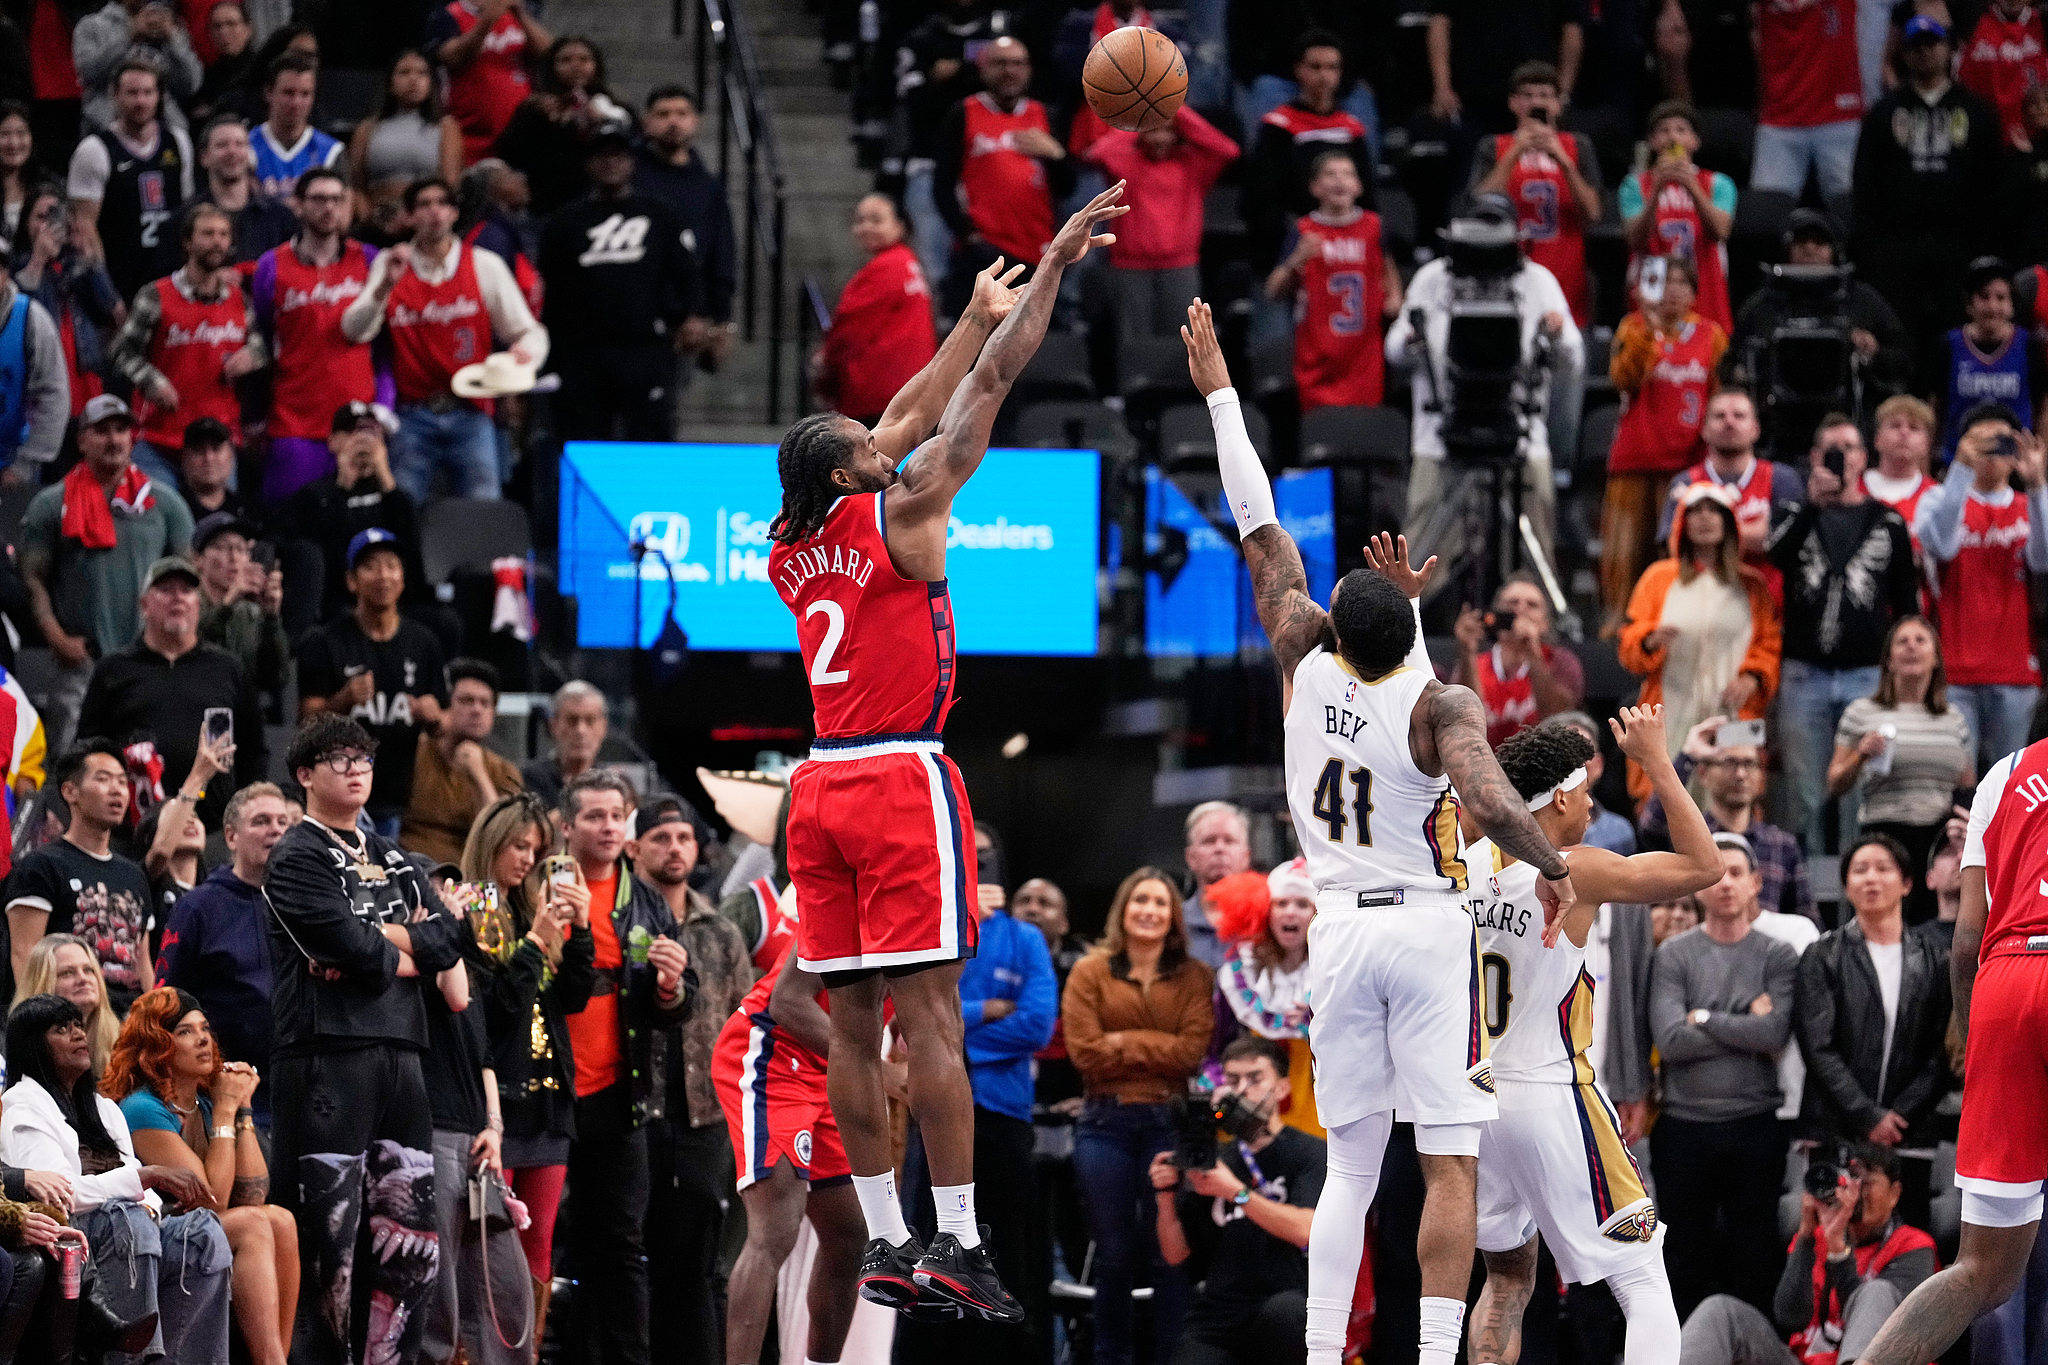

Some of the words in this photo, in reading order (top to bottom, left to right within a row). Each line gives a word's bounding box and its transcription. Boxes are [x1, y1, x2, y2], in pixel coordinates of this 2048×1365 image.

[1521, 178, 1560, 240] 3
[1327, 271, 1364, 336] 3
[454, 326, 476, 363] 3
[779, 544, 875, 599] LEONARD
[806, 600, 850, 686] 2
[350, 691, 413, 727] AIA
[1325, 705, 1368, 744] BEY
[1313, 756, 1375, 848] 41
[2014, 772, 2048, 813] JO
[1470, 899, 1532, 938] EARS
[1482, 951, 1514, 1040] 0
